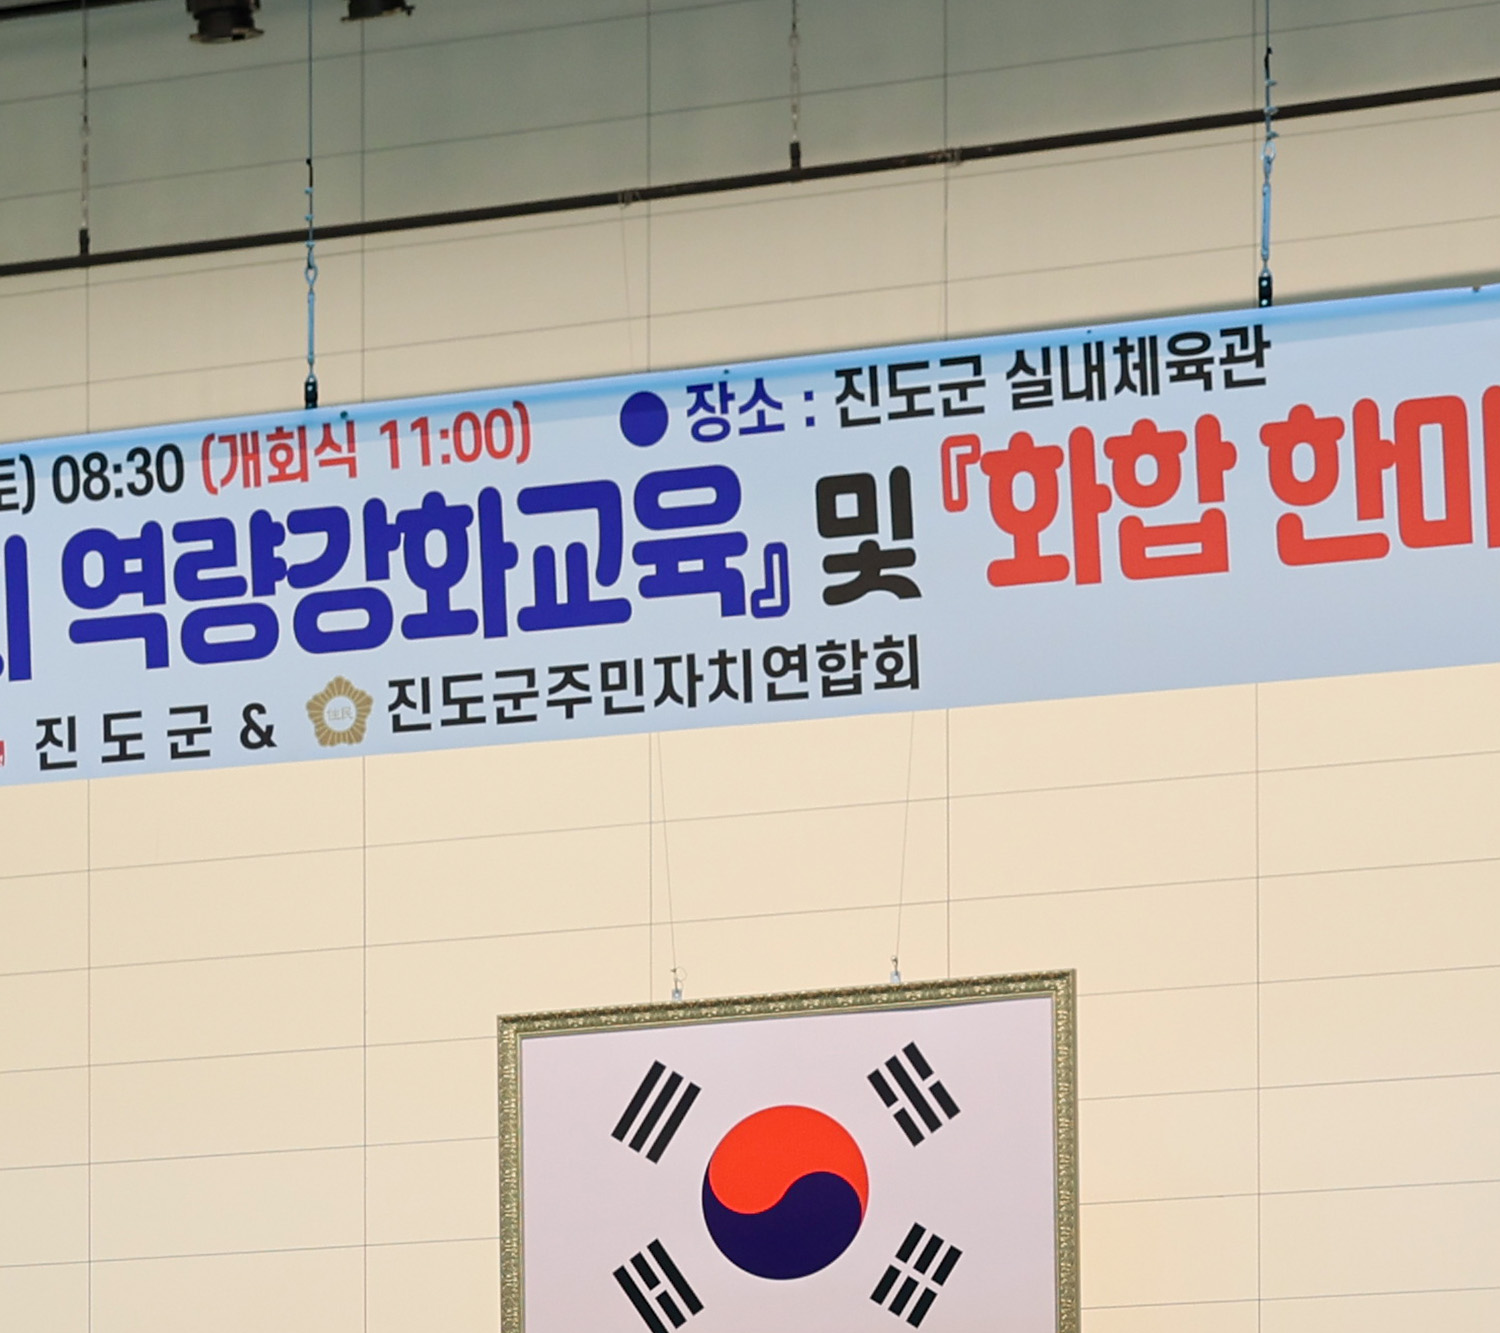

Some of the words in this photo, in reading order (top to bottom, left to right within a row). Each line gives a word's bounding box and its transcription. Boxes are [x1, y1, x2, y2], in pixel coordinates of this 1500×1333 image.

[686, 377, 784, 443] 장소
[834, 354, 986, 429] 진도군
[1005, 323, 1272, 412] 실내체육관
[52, 443, 185, 505] 08:30
[201, 418, 359, 496] (개회식
[379, 400, 532, 471] 11:00)
[815, 464, 923, 607] 및
[239, 702, 278, 750] &
[386, 634, 921, 734] 진도군주민자치연합회
